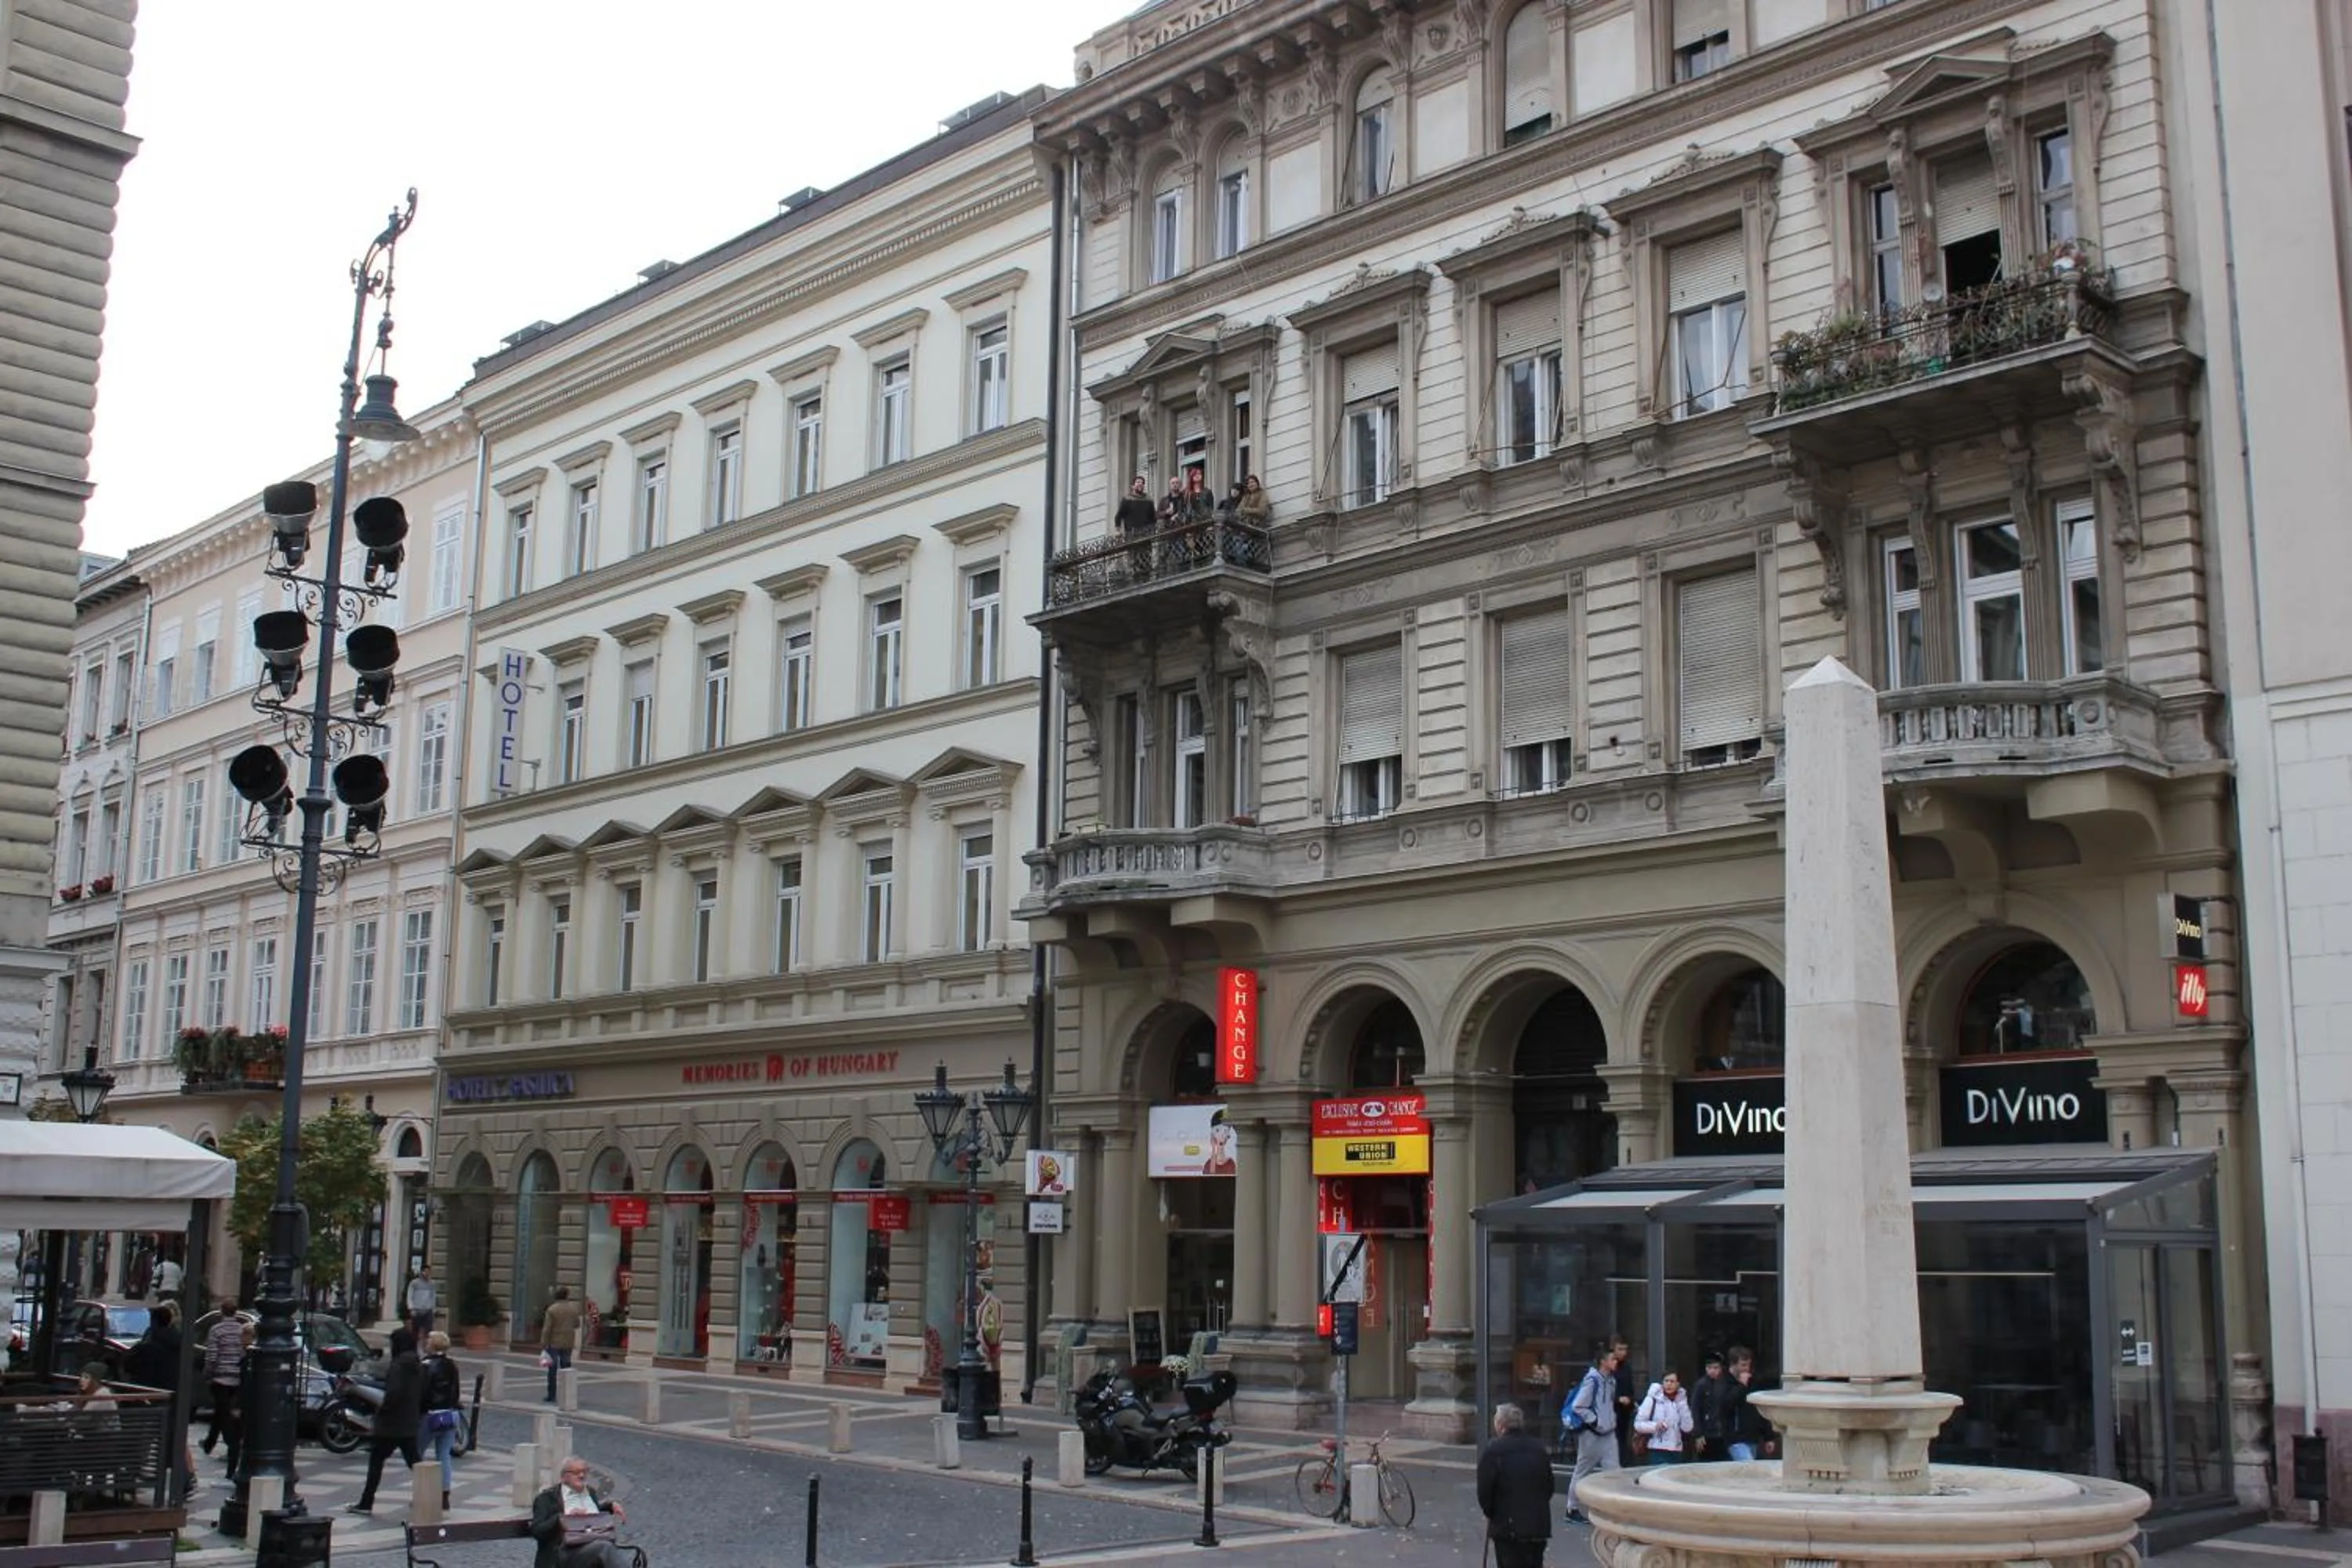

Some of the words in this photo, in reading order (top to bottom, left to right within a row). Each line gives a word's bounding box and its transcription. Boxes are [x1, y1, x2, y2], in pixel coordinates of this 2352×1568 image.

[499, 653, 522, 787] HOTEL
[2180, 972, 2205, 1013] illy
[1232, 972, 1248, 1079] CHANGE
[681, 1061, 760, 1084] MEMORIES
[789, 1056, 811, 1078] OF
[816, 1048, 900, 1076] HUNGARY
[1696, 1100, 1786, 1137] DiVino
[1966, 1086, 2080, 1125] DiVino
[1348, 1144, 1387, 1152] WESTERN
[1359, 1151, 1388, 1160] UNION
